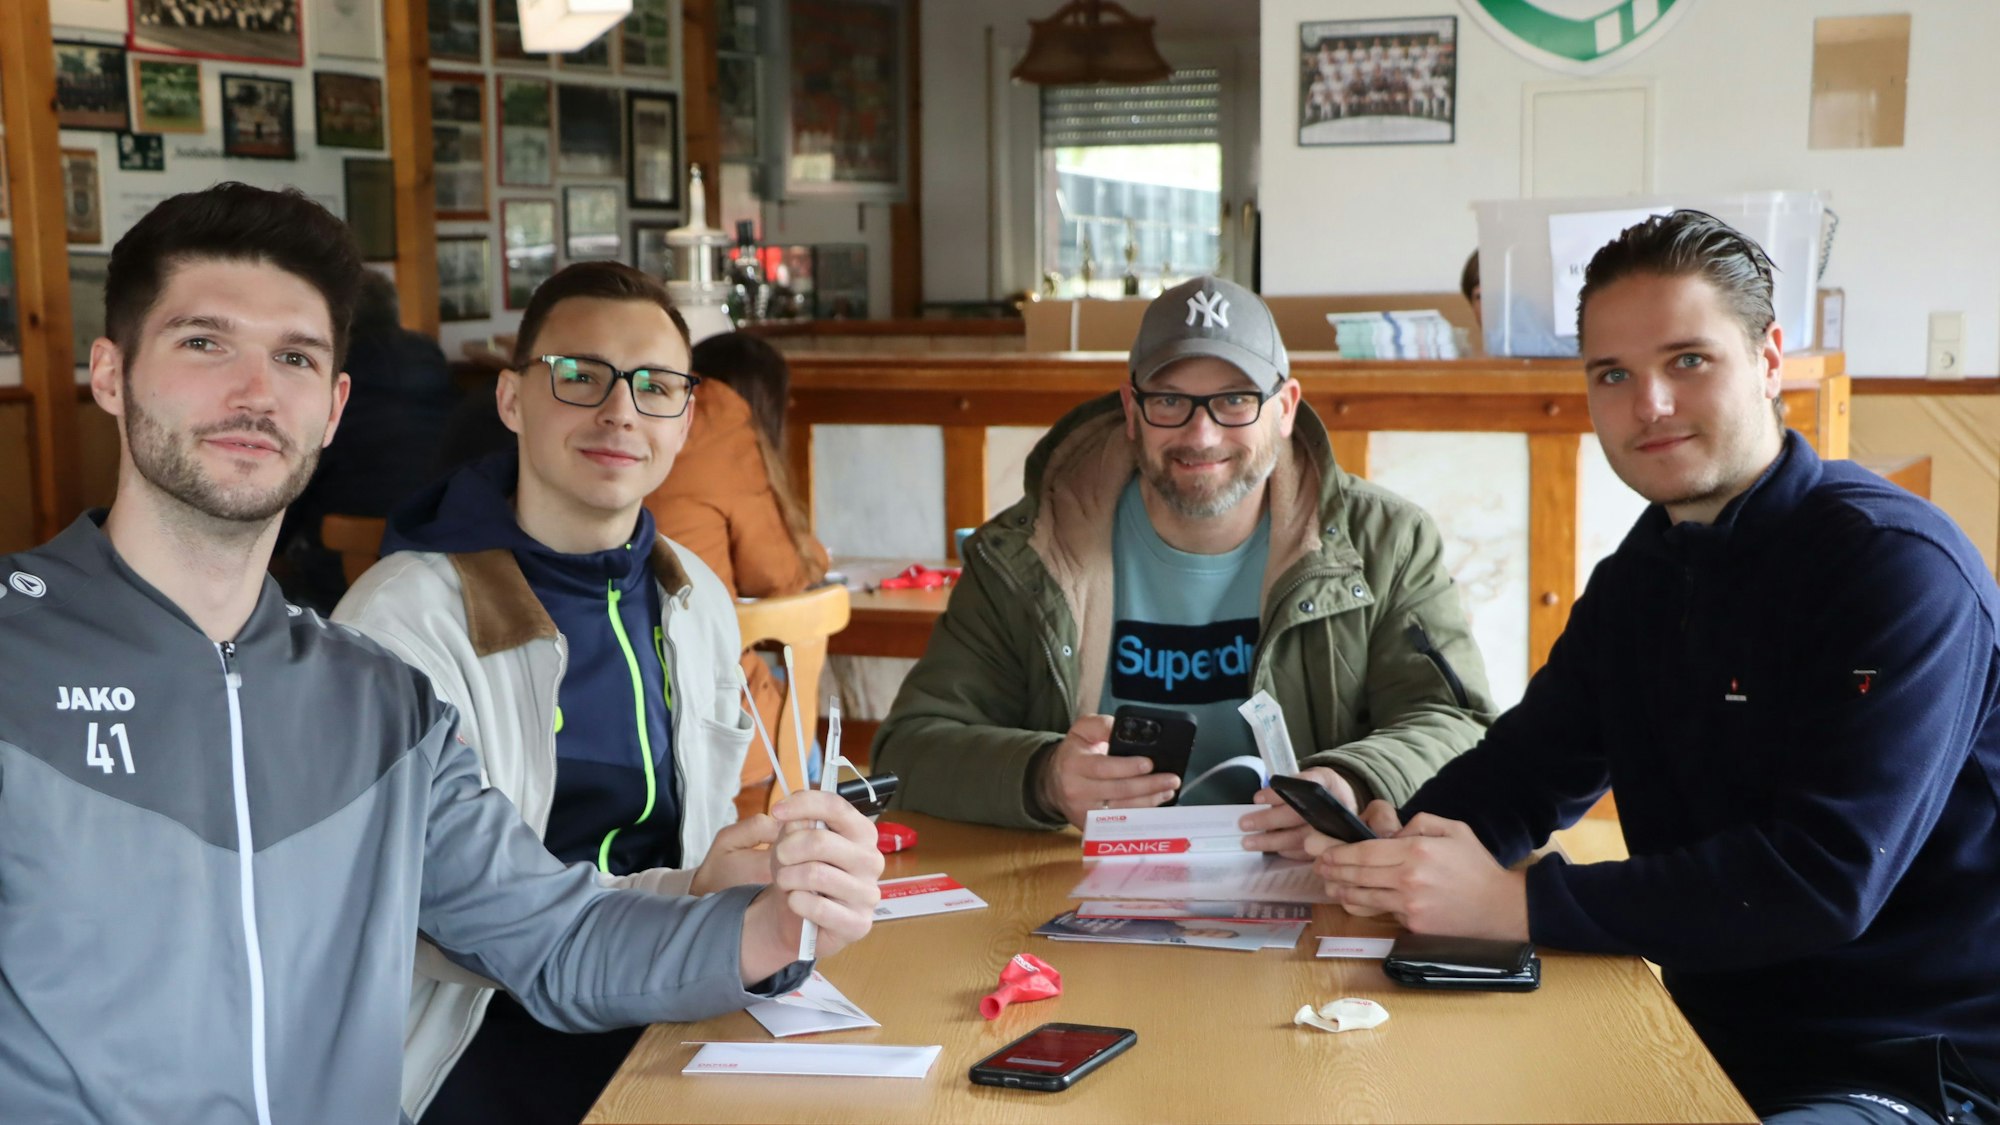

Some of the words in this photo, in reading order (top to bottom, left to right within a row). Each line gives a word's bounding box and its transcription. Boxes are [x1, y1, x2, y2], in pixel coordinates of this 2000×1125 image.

[56, 686, 136, 712] JAKO
[86, 722, 136, 774] 41
[1096, 841, 1172, 855] DANKE
[1848, 1093, 1909, 1114] JAKO
